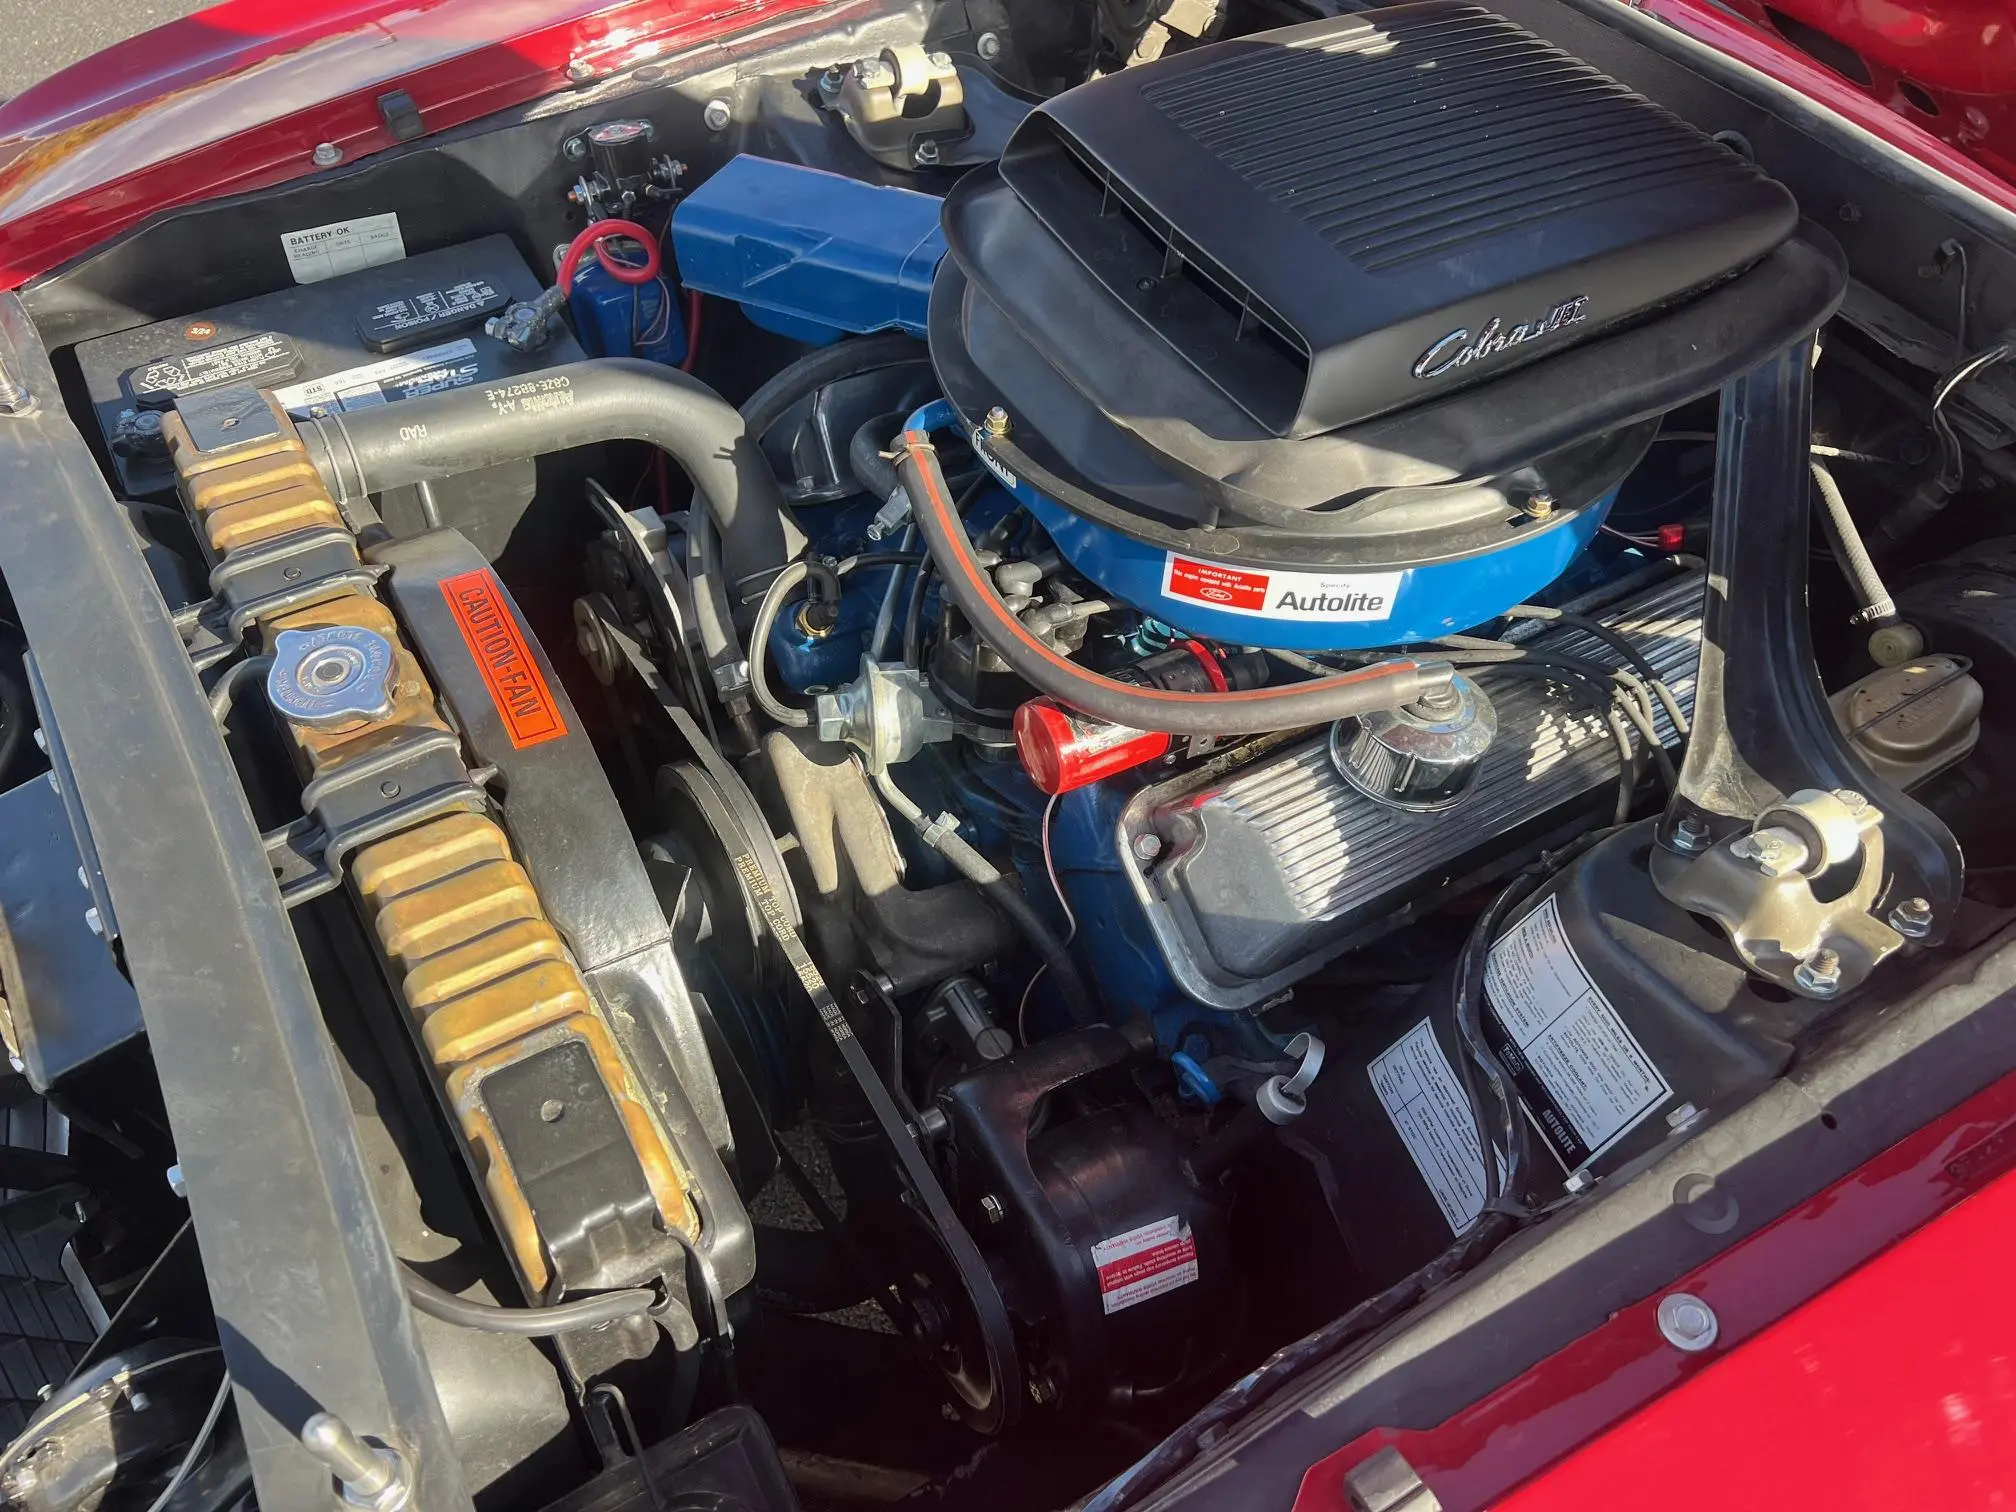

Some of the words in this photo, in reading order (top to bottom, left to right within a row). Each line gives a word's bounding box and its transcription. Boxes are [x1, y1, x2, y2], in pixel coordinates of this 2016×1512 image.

[290, 230, 332, 246] BATTERY
[336, 226, 350, 236] OK
[437, 303, 476, 317] DANGER
[394, 316, 429, 329] POISON
[405, 373, 471, 398] SUPER
[398, 423, 427, 441] RAD
[1198, 568, 1242, 582] IMPORTANT
[1276, 591, 1383, 612] Autolite
[458, 586, 541, 718] CAUTION-FAN
[734, 857, 762, 895] PREMIUM
[760, 900, 775, 916] TOP
[771, 919, 790, 941] CORD
[741, 853, 769, 892] PREMIUM
[768, 897, 783, 912] TOP
[778, 915, 797, 937] CORD
[800, 962, 819, 989] 15520
[1543, 1108, 1575, 1154] AUTOLITE
